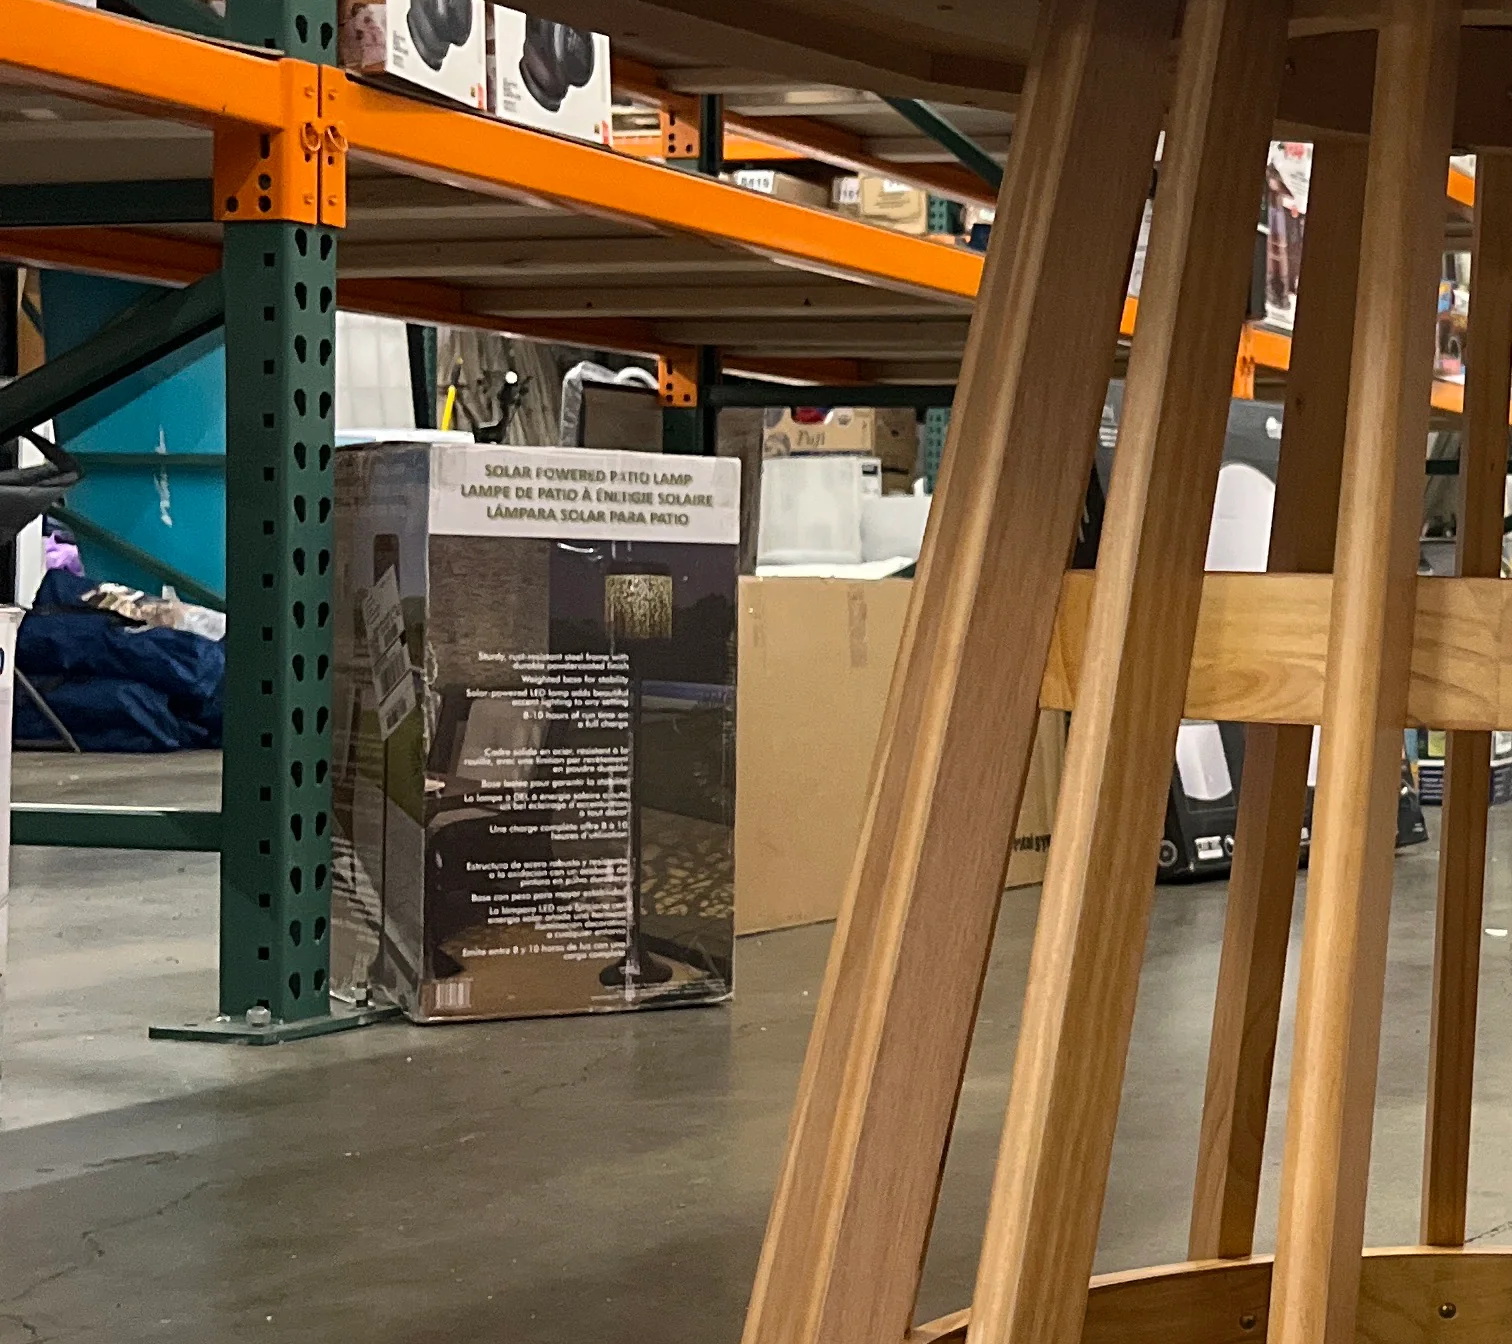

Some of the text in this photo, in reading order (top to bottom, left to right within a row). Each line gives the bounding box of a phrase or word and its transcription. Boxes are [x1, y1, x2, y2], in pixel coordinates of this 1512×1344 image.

[485, 464, 693, 486] SOLAR POWERED PATIO LAMP
[461, 484, 510, 498] LAMPE
[515, 486, 533, 499] DE
[538, 487, 578, 502] PATIO
[658, 491, 714, 507] SOLAIRE
[487, 503, 690, 526] LÁMPARA SOLAR PARA PATIO
